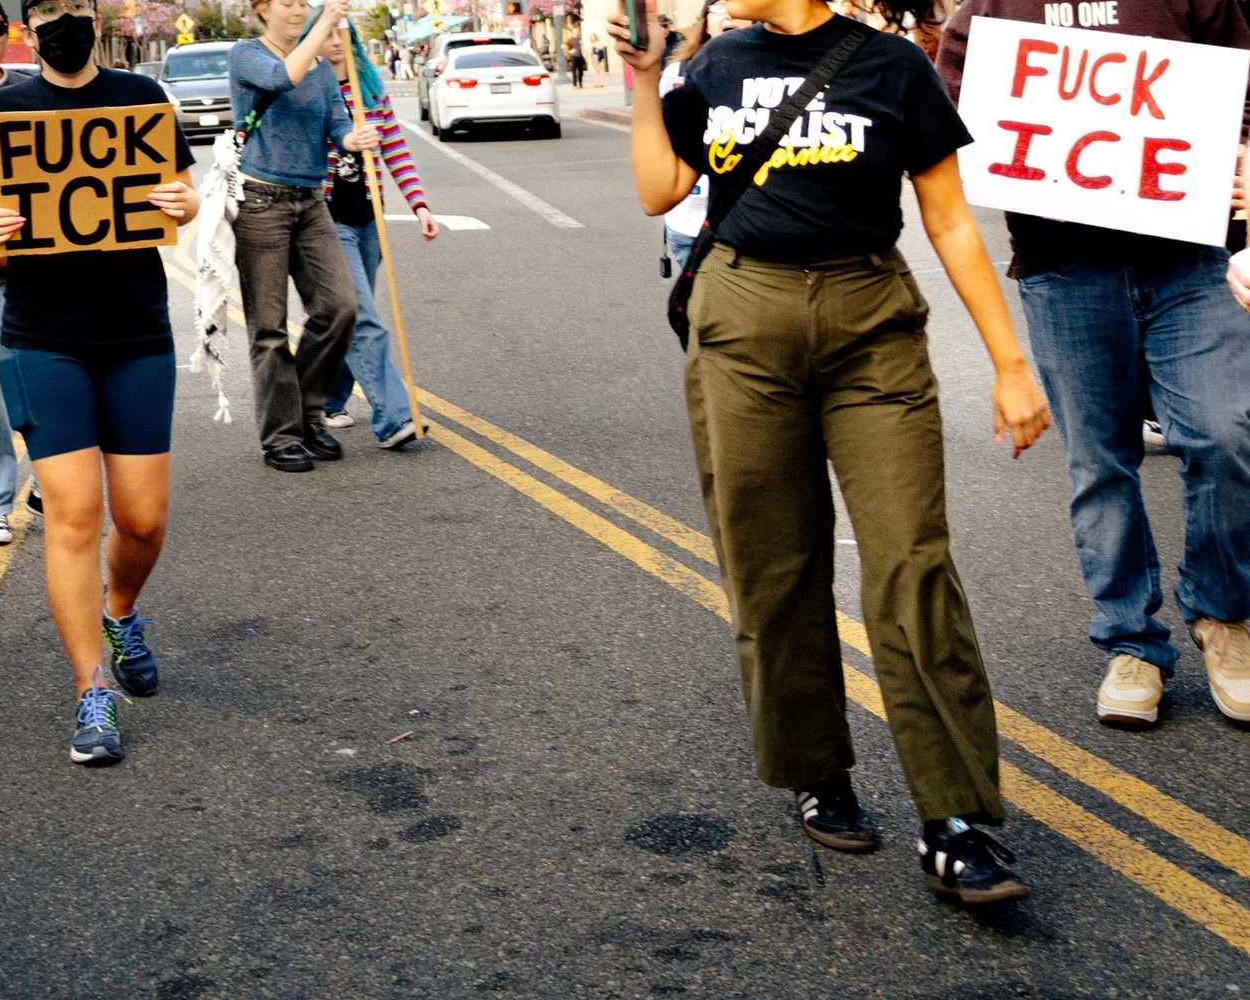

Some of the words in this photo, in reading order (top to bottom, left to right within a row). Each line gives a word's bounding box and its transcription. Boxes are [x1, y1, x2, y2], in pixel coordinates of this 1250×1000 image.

[1044, 3, 1073, 27] NO
[1078, 0, 1119, 27] ONE
[1010, 38, 1170, 120] FUCK
[703, 106, 872, 152] SOCILIST
[988, 119, 1191, 202] I.C.E
[1, 173, 165, 250] ICE
